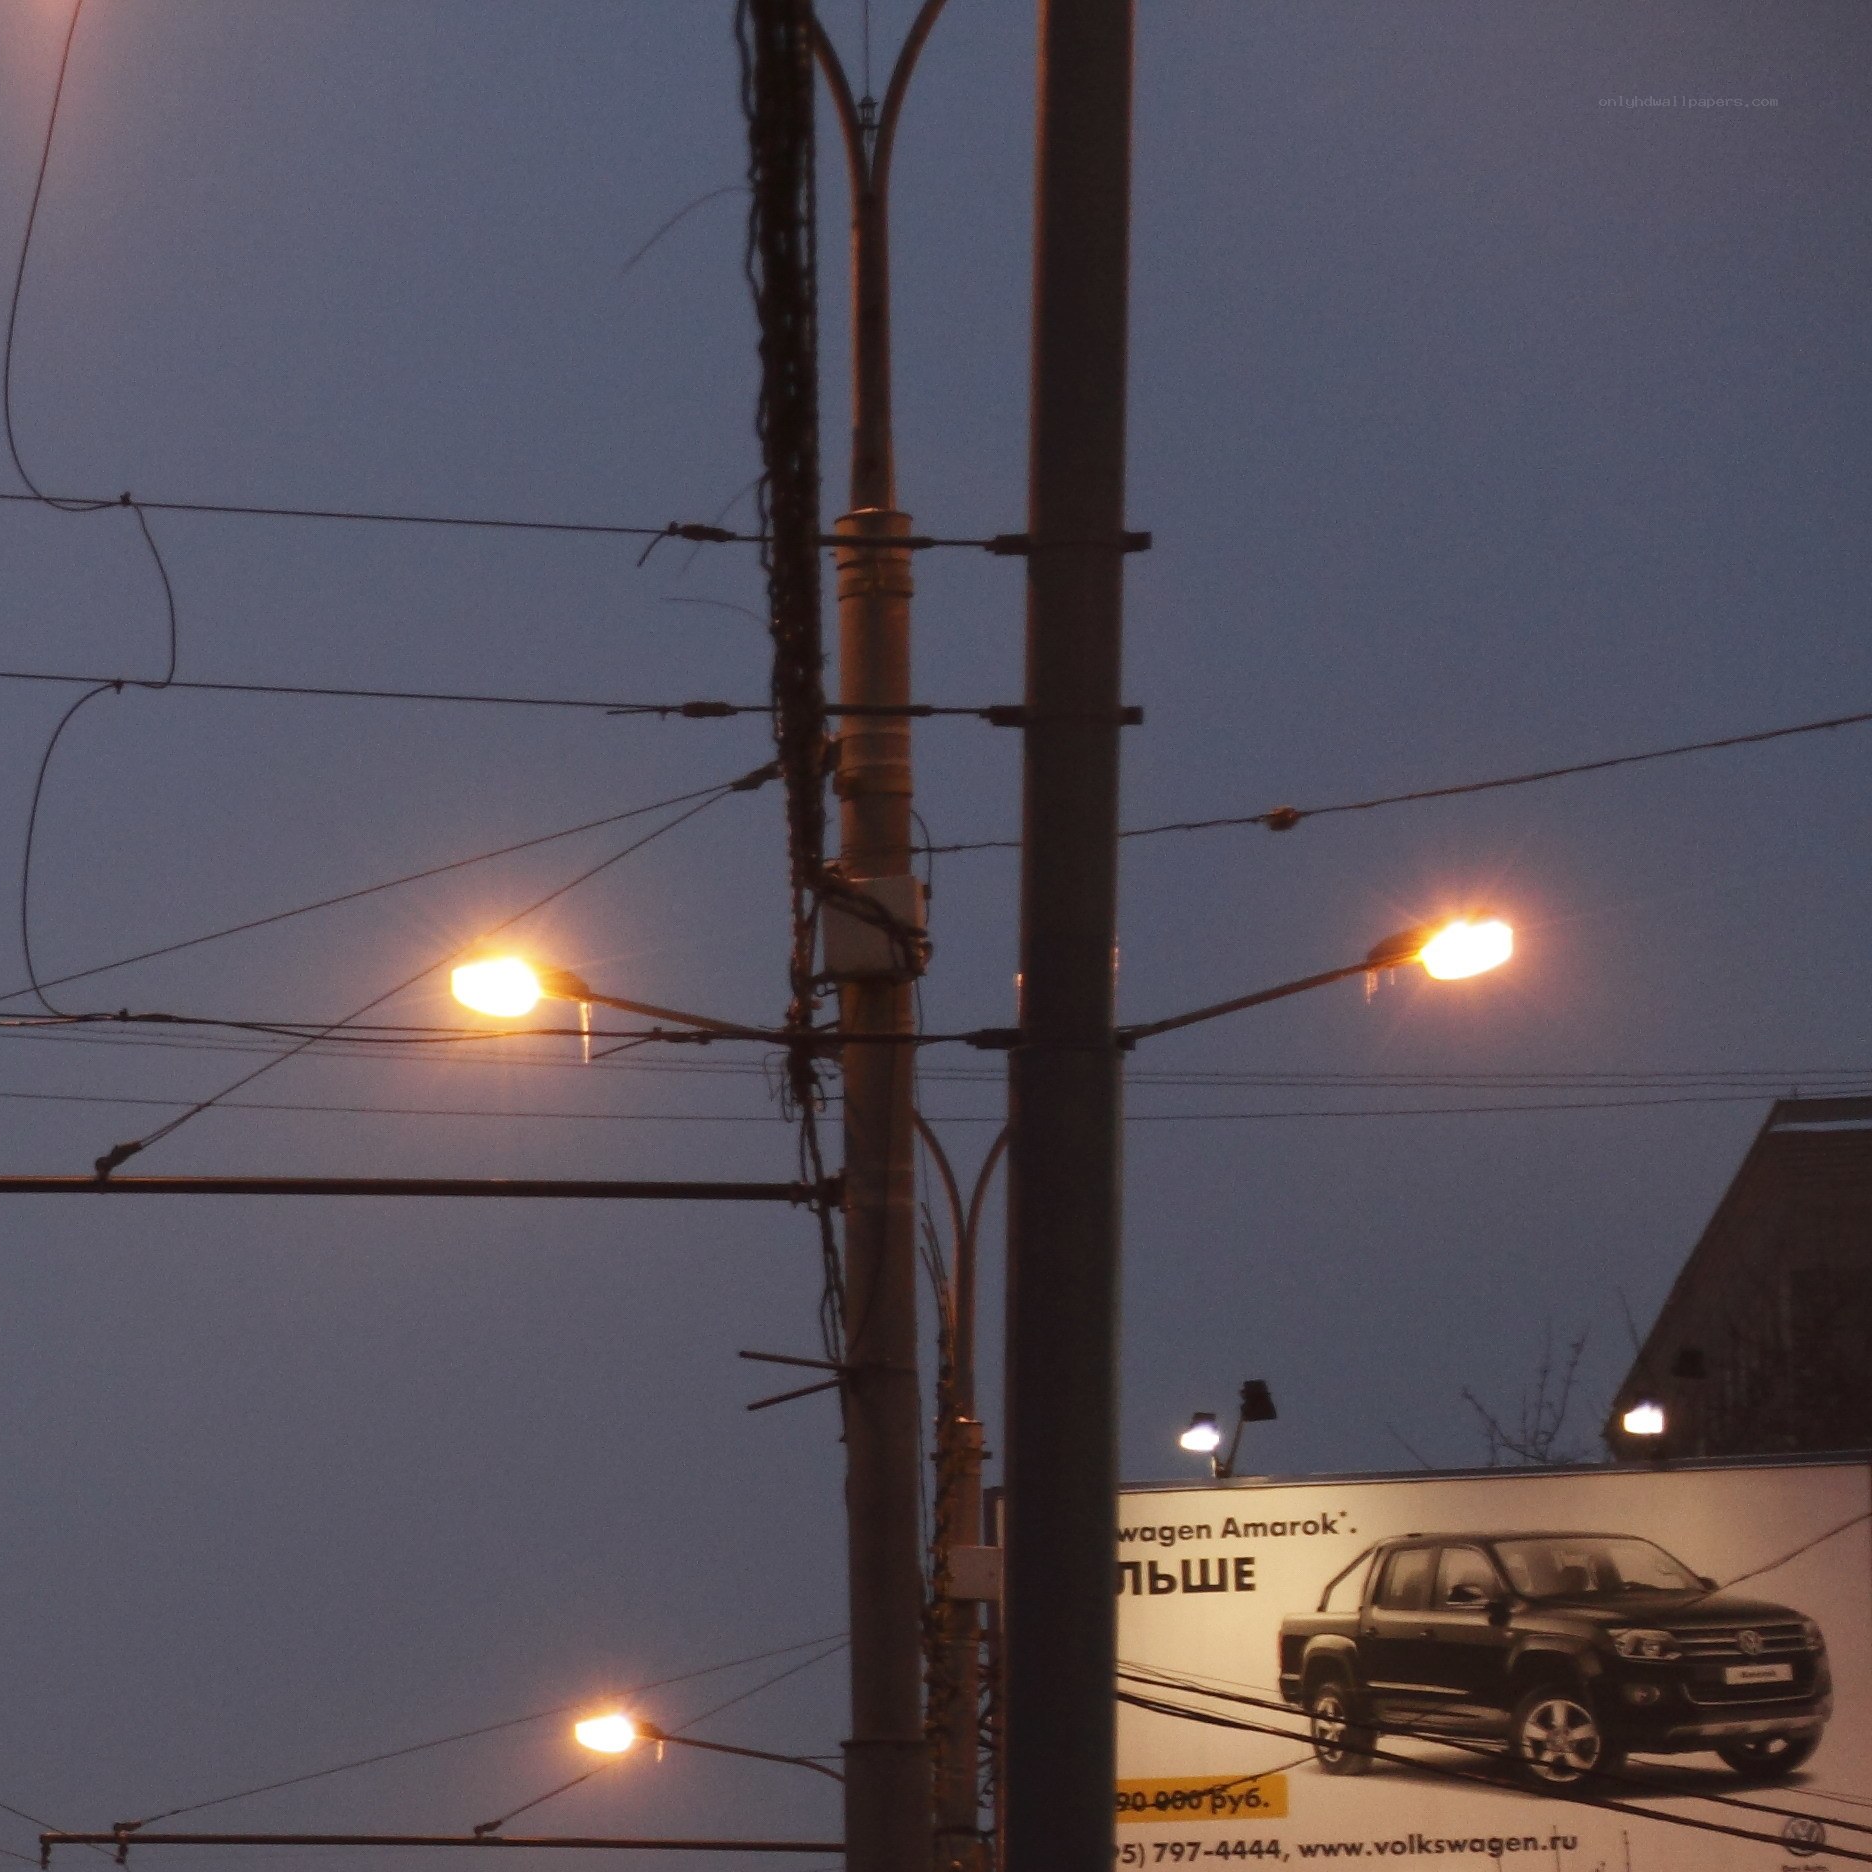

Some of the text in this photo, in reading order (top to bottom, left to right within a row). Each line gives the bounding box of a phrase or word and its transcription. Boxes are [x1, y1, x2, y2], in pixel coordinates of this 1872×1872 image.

[1155, 1790, 1203, 1810] 000
[1211, 1787, 1270, 1814] руб.
[1152, 1838, 1290, 1863] 797-4444,
[1298, 1832, 1579, 1860] www.volkswagen.ru
